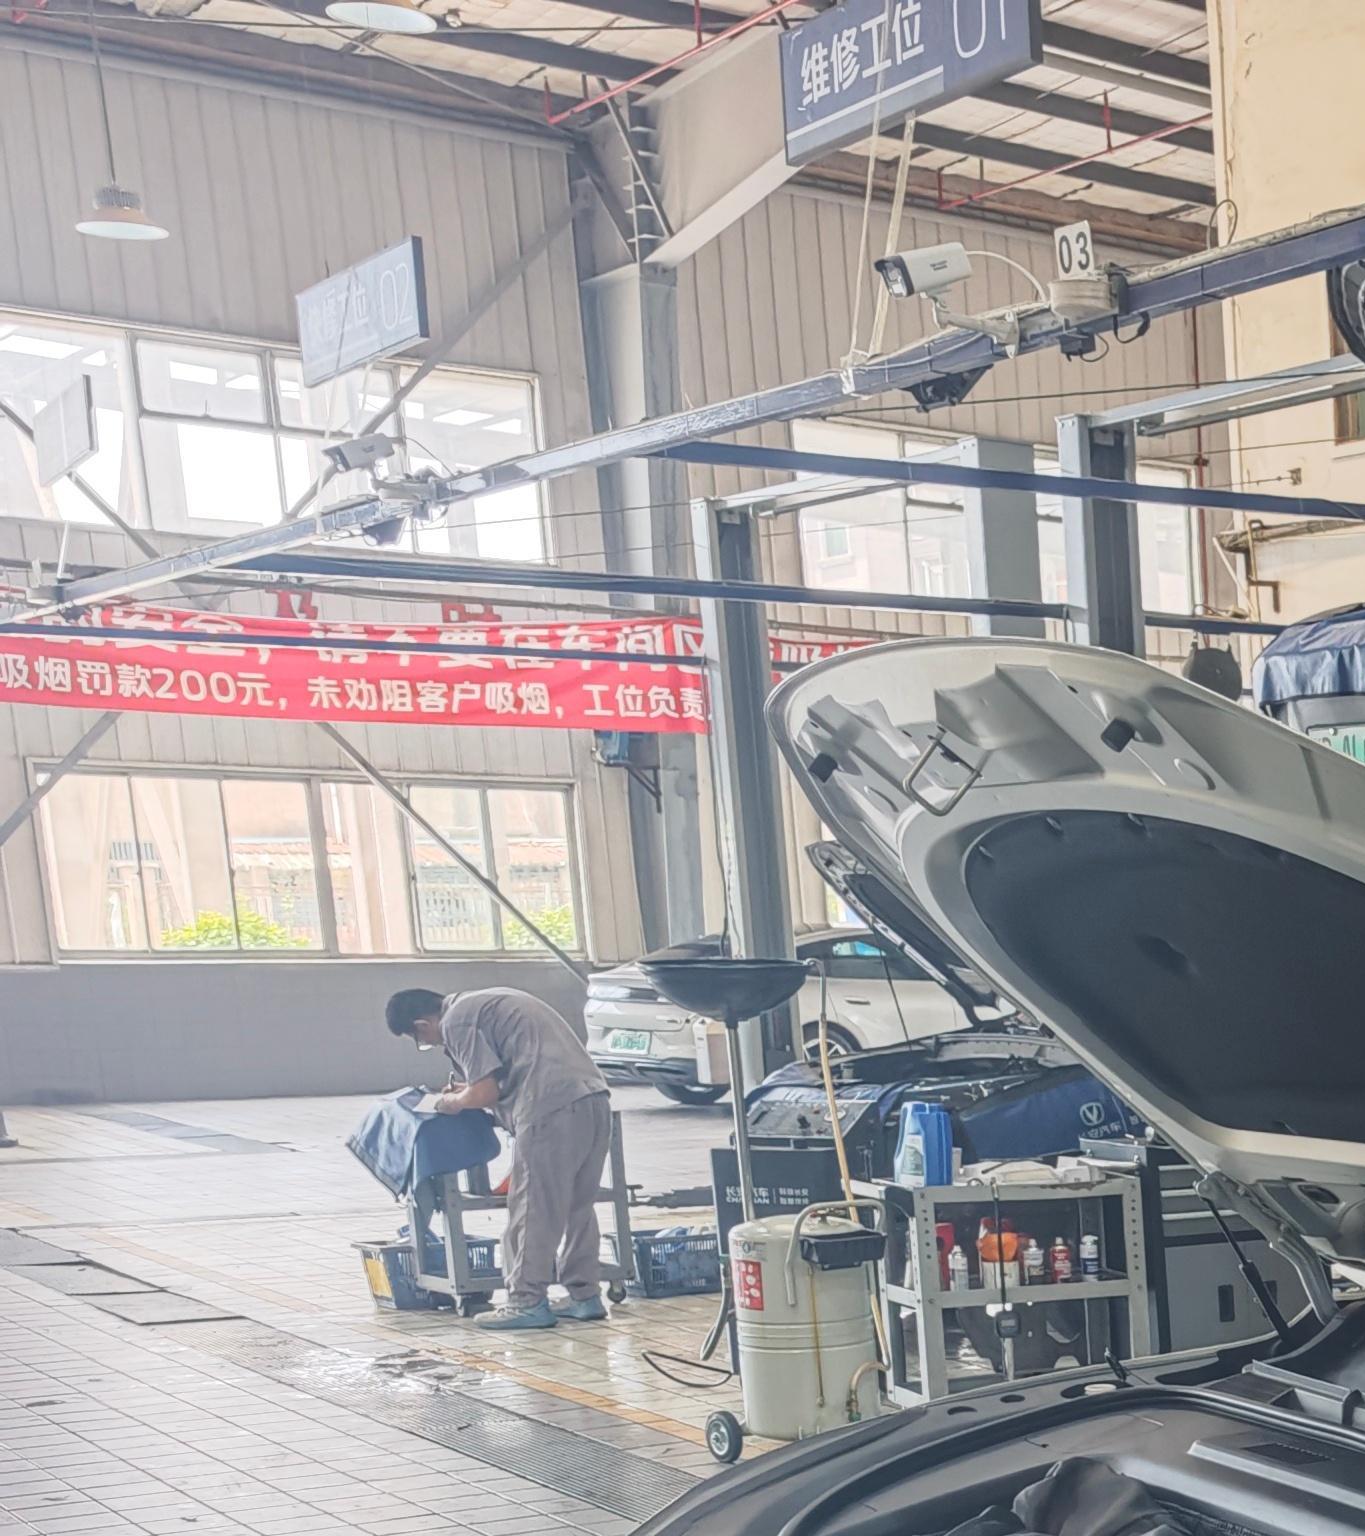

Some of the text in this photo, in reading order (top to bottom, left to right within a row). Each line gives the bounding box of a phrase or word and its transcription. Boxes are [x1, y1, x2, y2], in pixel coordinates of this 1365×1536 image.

[801, 0, 924, 106] 维修工位
[1058, 231, 1090, 274] 03
[380, 263, 413, 330] 02
[0, 653, 712, 721] 吸烟罚款200元，未劝阻客户吸烟，工位负责
[726, 1186, 769, 1197] 长车
